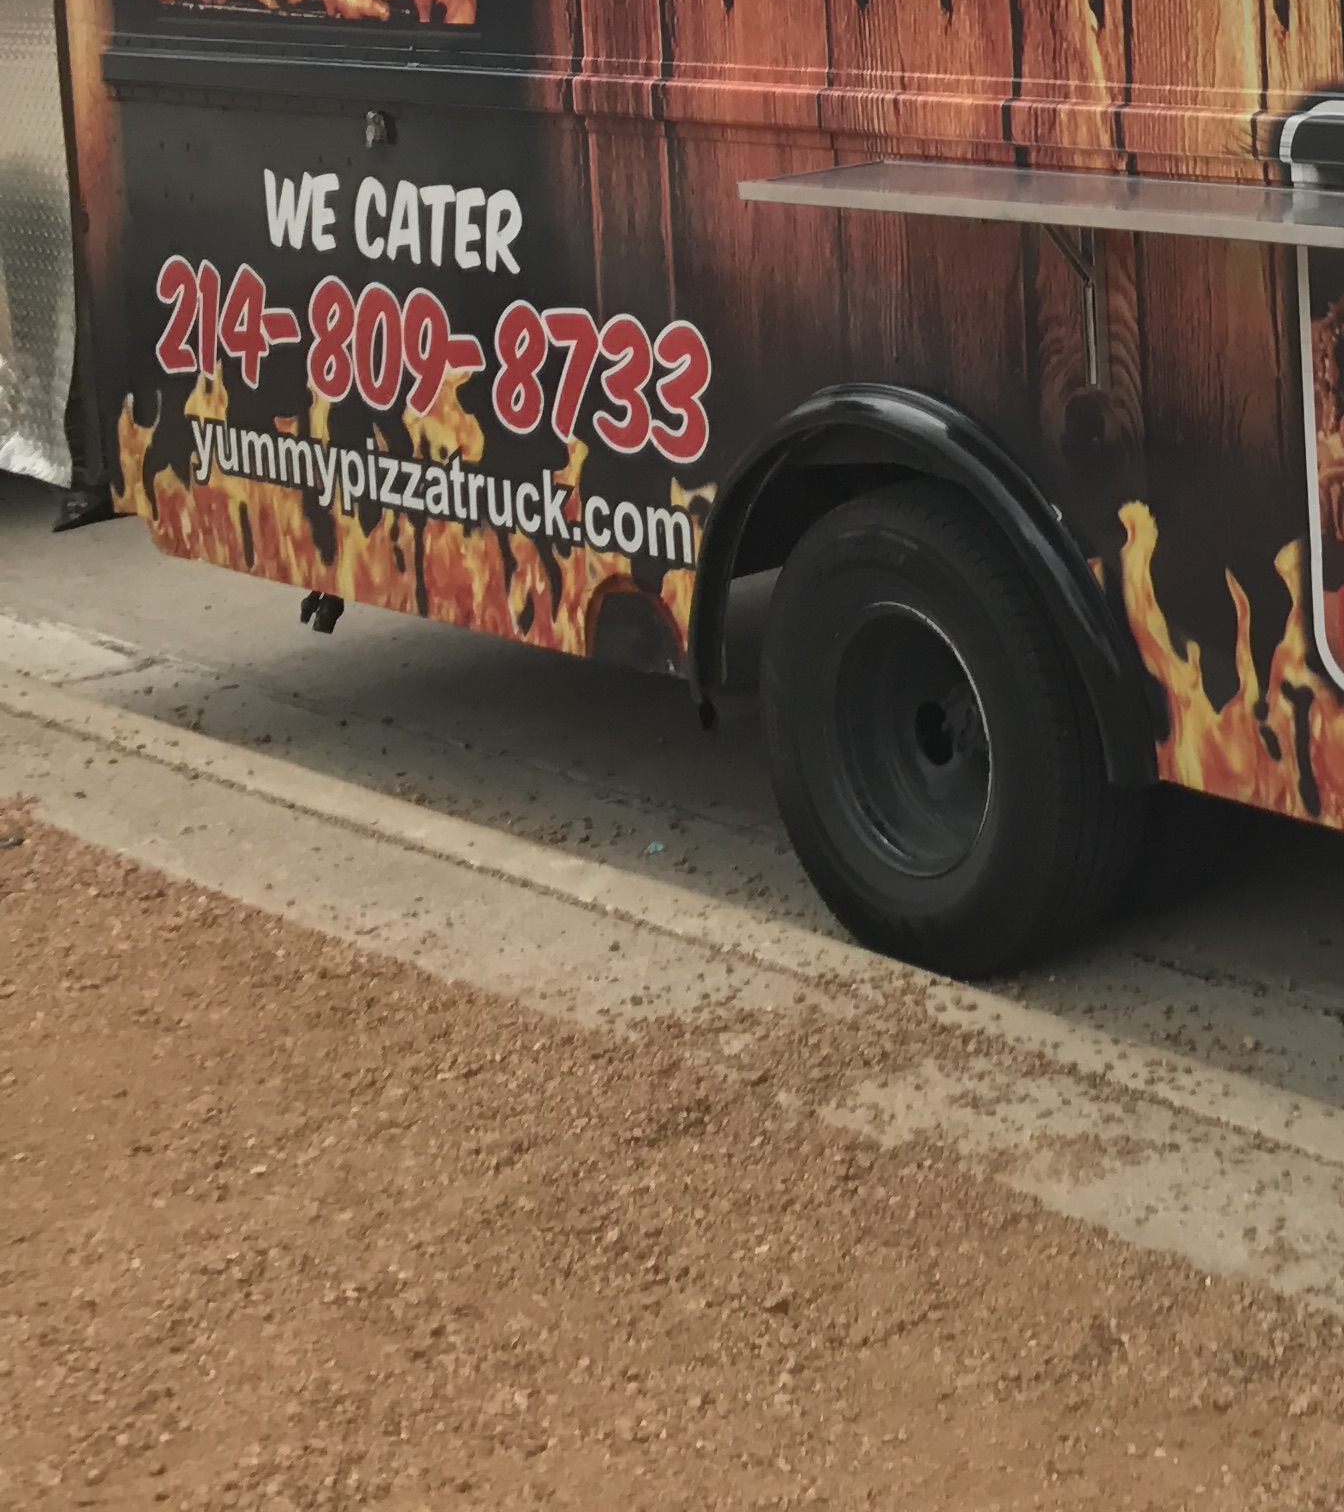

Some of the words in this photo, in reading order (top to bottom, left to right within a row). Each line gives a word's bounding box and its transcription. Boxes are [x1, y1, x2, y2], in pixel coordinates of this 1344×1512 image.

[264, 168, 341, 250] WE
[353, 176, 523, 275] CATER
[190, 417, 695, 565] yummypizzatruck.com
